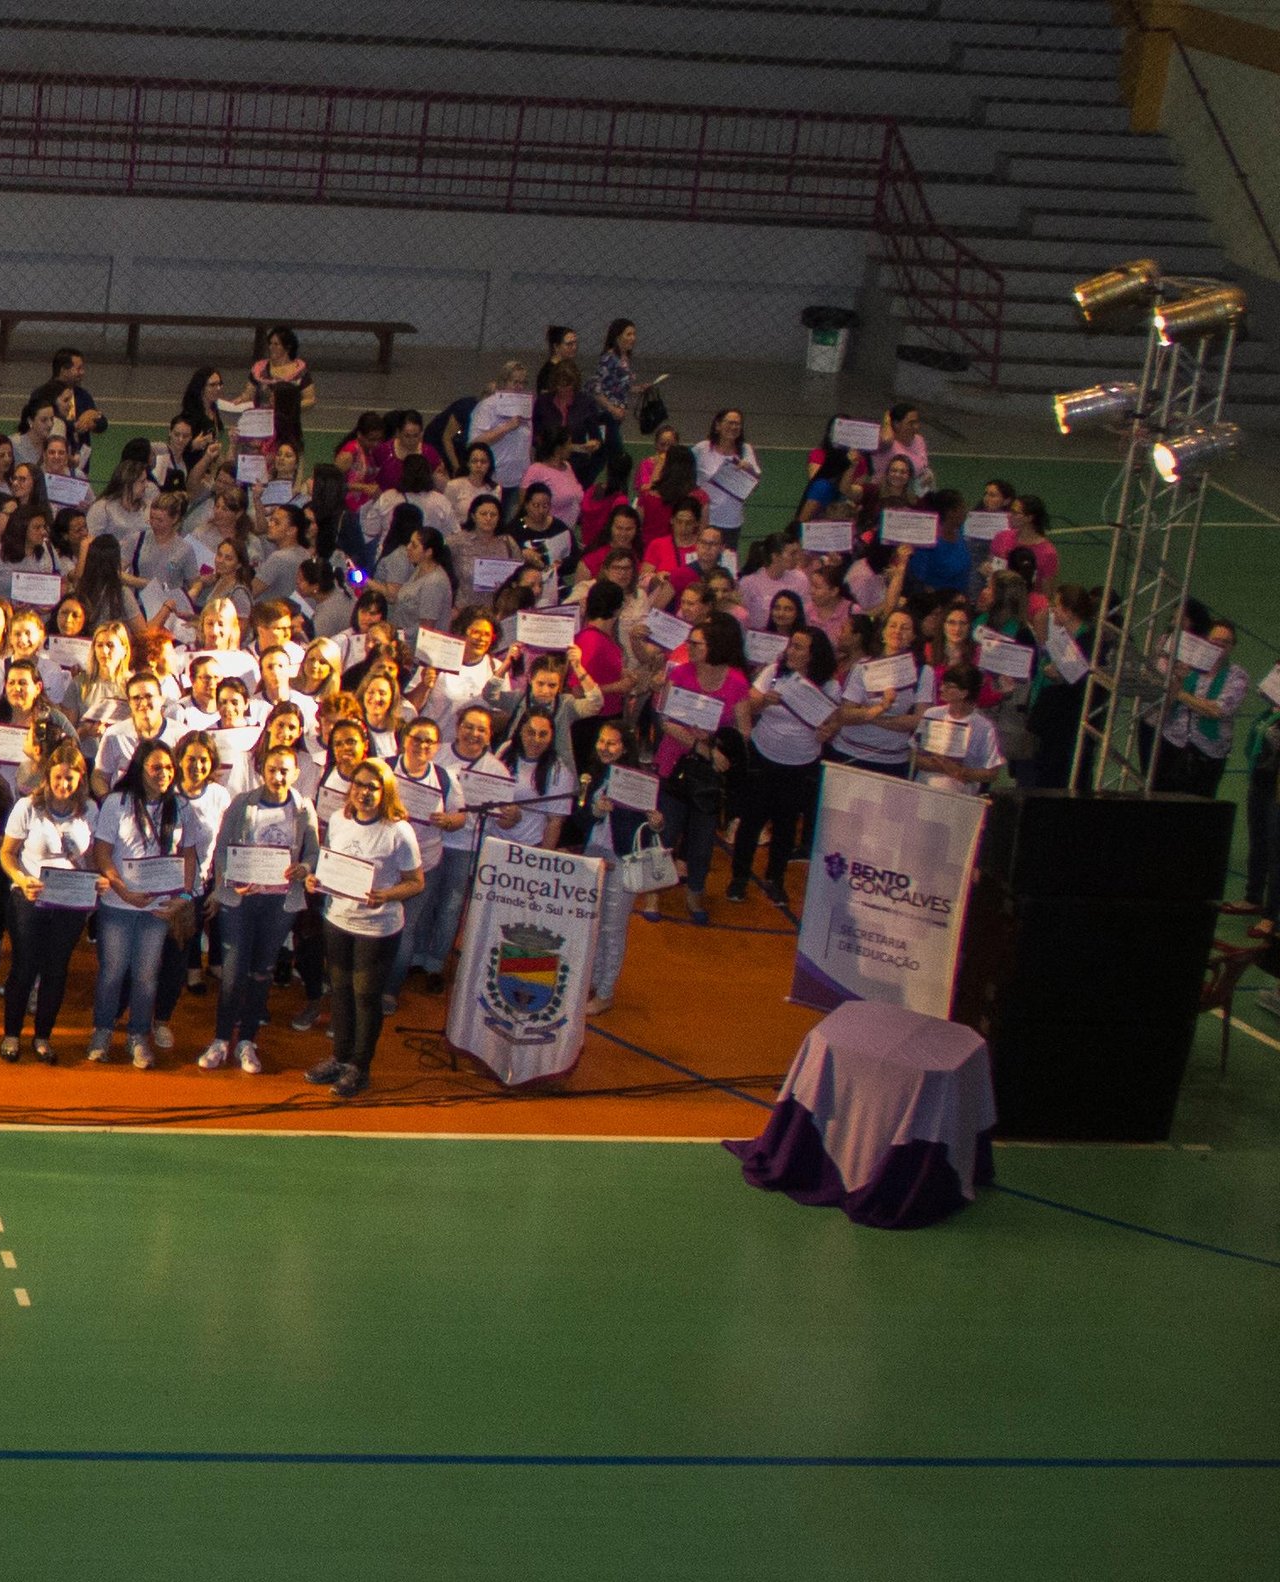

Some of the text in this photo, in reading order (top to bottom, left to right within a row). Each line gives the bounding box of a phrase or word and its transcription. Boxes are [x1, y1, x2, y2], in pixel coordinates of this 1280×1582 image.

[507, 844, 575, 875] Bento
[478, 864, 598, 904] Gonçalves
[850, 861, 911, 889] BENTO
[485, 890, 526, 908] Grande
[528, 899, 543, 912] do
[545, 903, 564, 916] Sul
[575, 907, 596, 920] Bra
[848, 875, 951, 914] GONÇALVES
[840, 924, 907, 951] SECRETARIA
